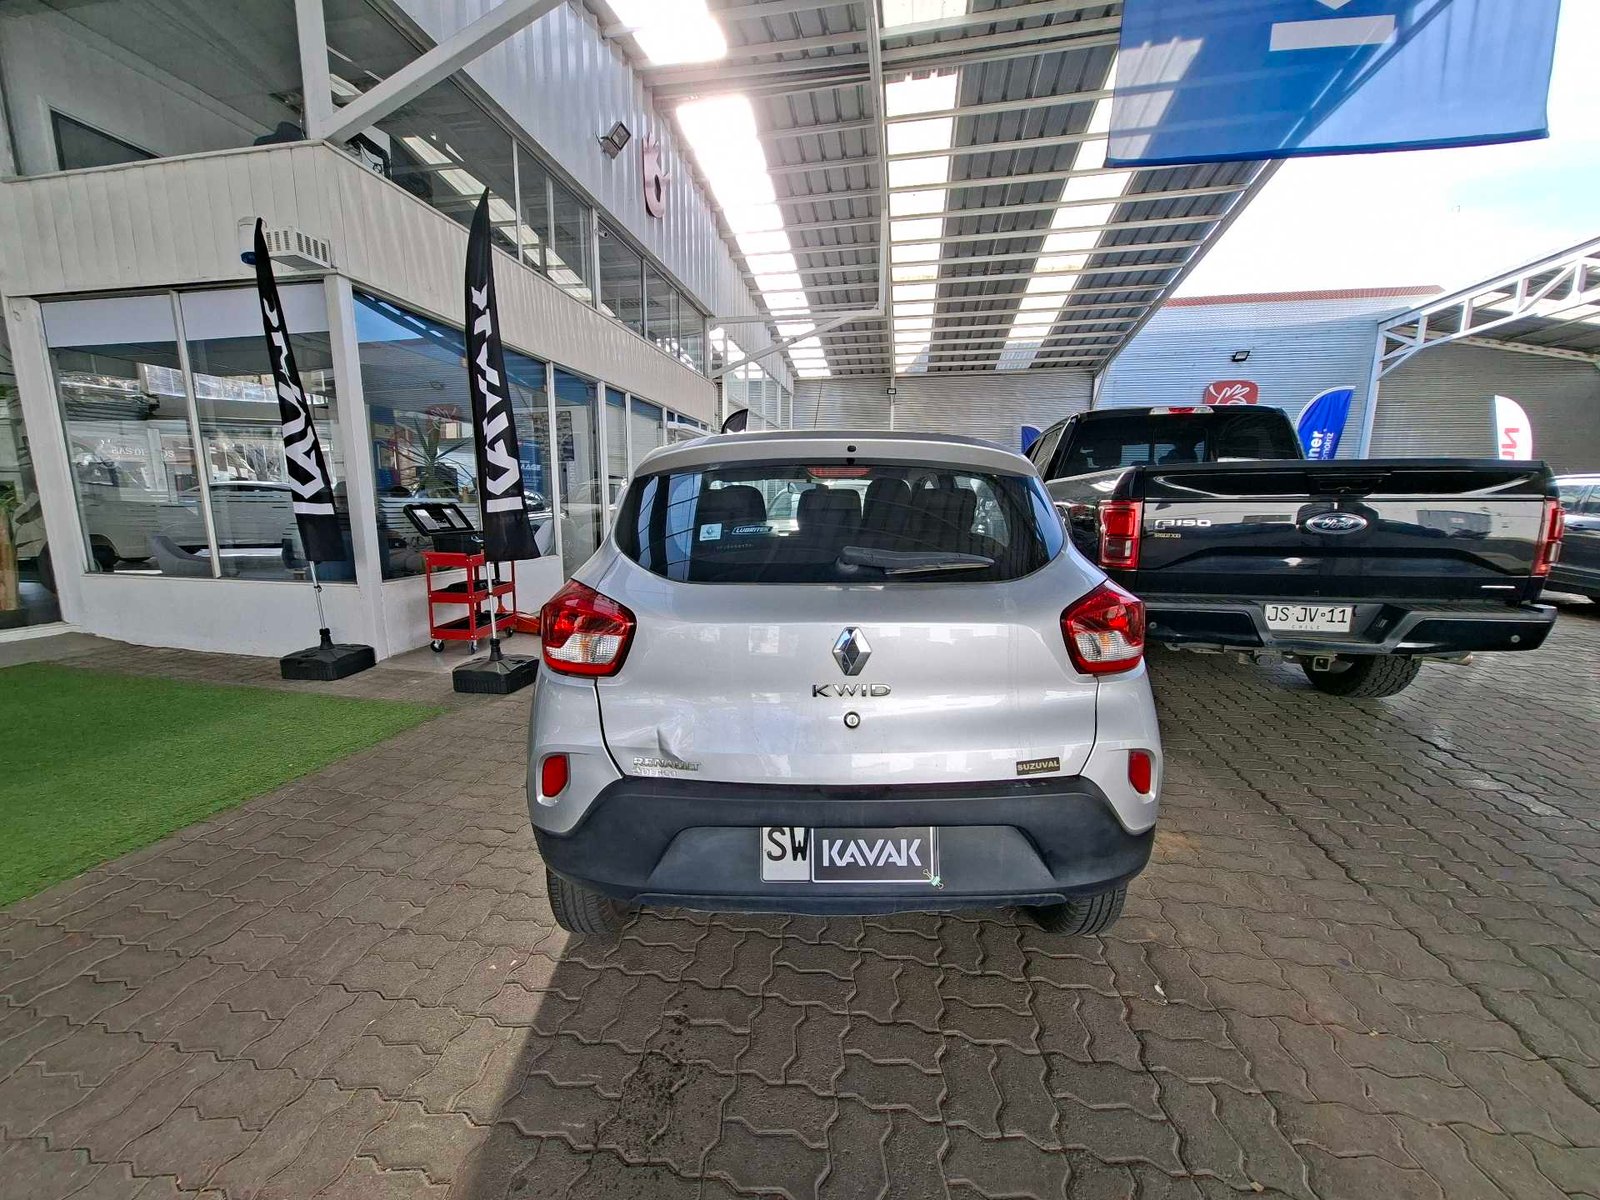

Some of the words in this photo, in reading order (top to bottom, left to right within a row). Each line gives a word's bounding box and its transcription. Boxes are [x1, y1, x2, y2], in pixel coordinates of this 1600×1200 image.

[1307, 431, 1324, 460] ner
[1321, 515, 1354, 530] Ford
[812, 683, 891, 697] KWID
[633, 757, 702, 771] RENAULT
[1017, 760, 1060, 771] SUZUVAL
[822, 838, 922, 867] KAVAK
